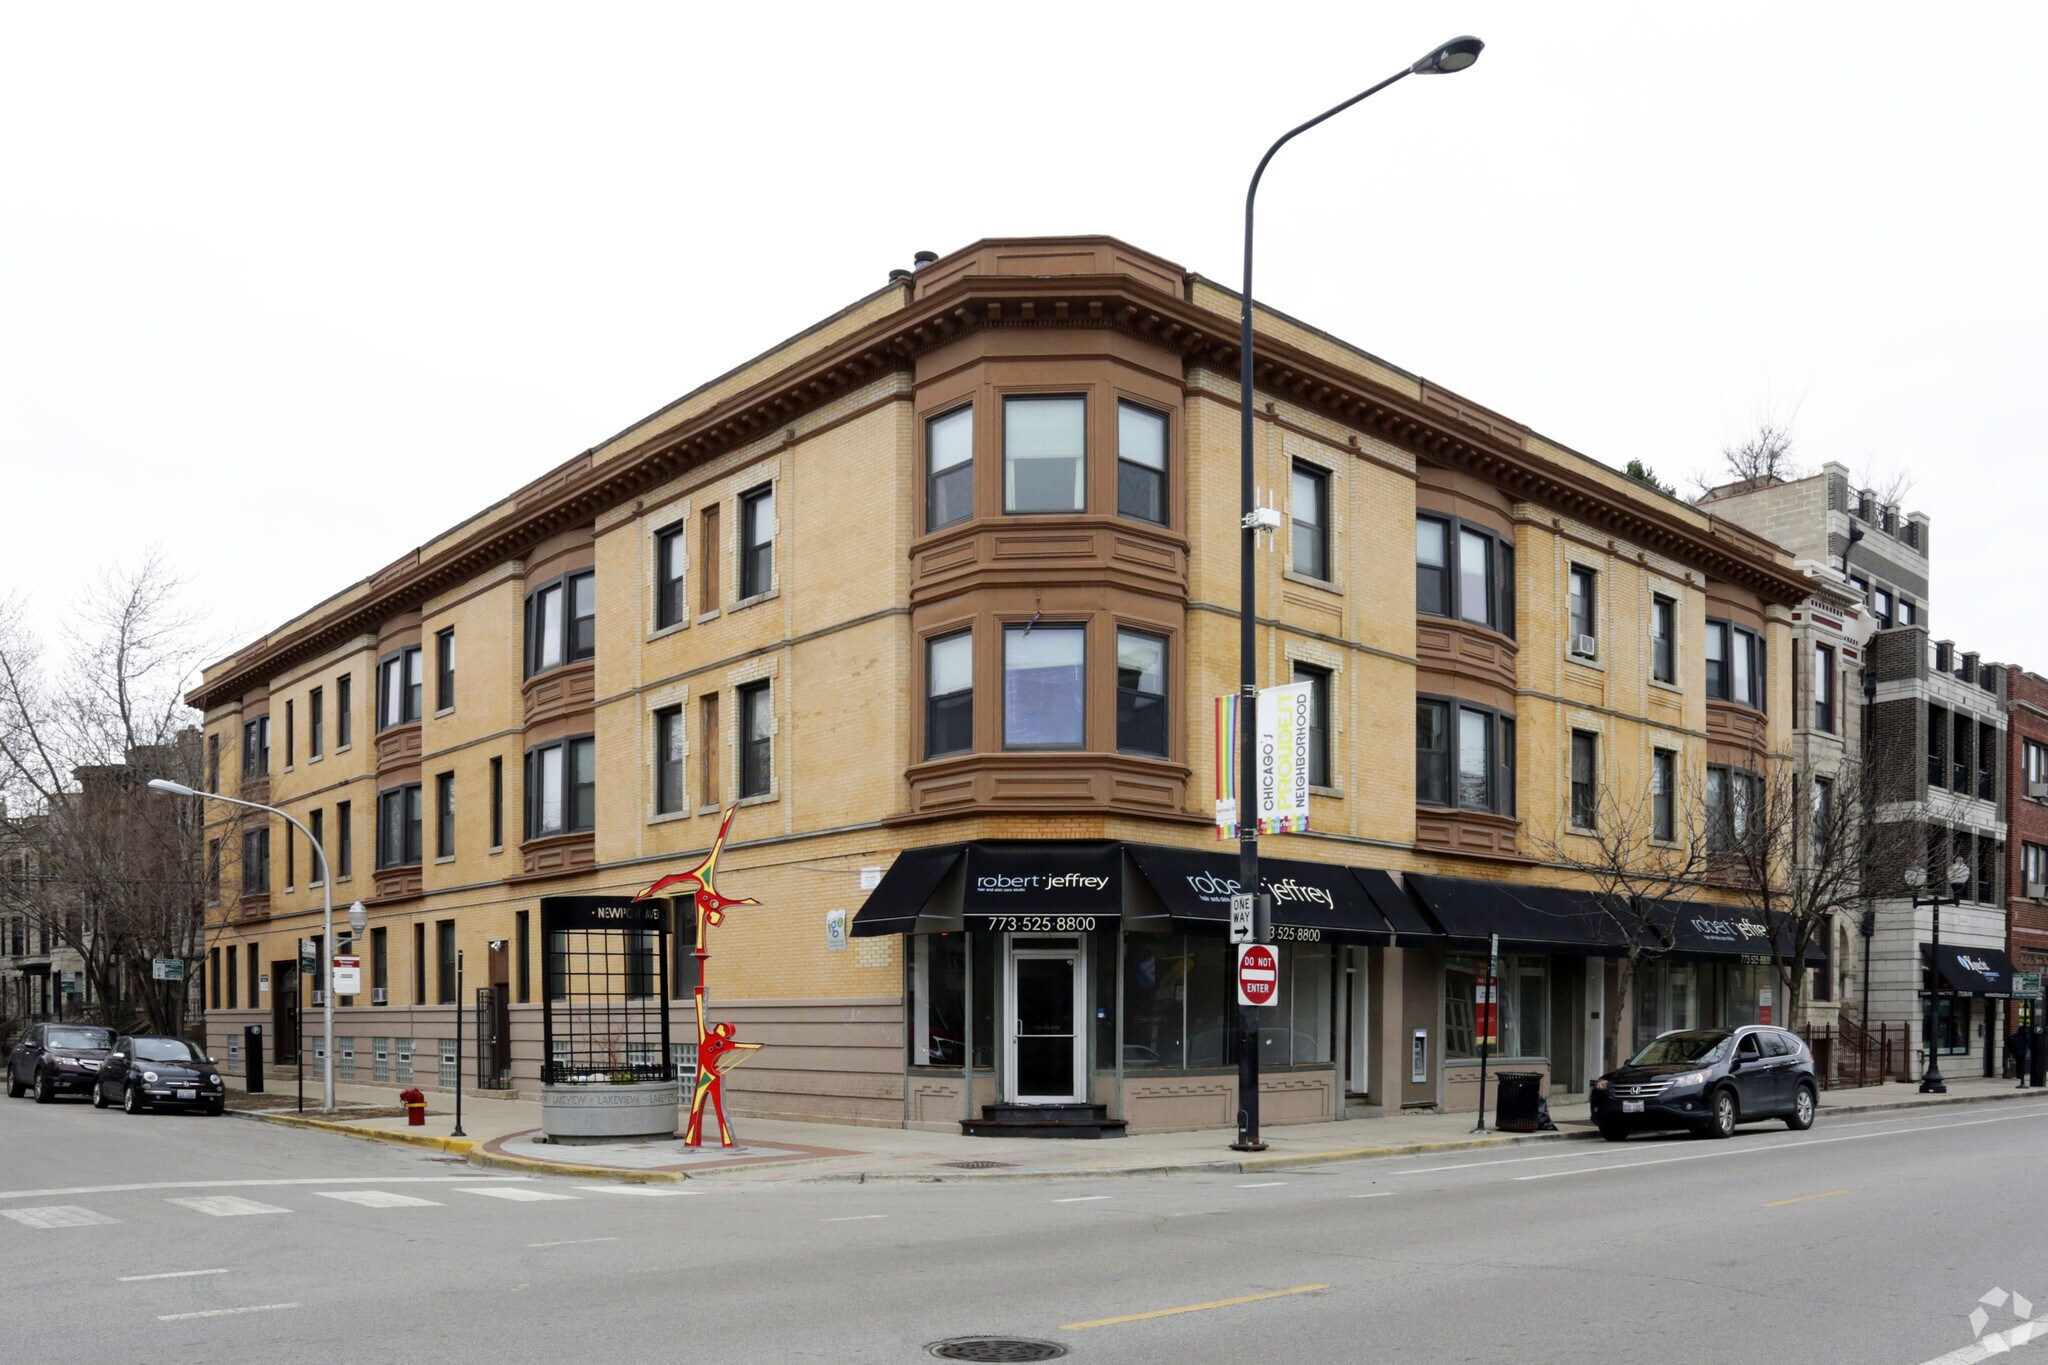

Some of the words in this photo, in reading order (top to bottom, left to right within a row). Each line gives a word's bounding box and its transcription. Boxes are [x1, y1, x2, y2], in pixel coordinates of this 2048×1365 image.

[1295, 693, 1307, 809] NEIGHBORHOOD
[977, 873, 1040, 888] robert
[1045, 873, 1109, 891] jeffrey
[1186, 870, 1242, 896] robe
[1263, 877, 1334, 910] jeffrey
[1233, 898, 1250, 911] ONE
[1233, 911, 1250, 924] WAY
[1244, 956, 1255, 967] DO
[1257, 957, 1273, 967] NOT
[1247, 983, 1270, 993] ENTER
